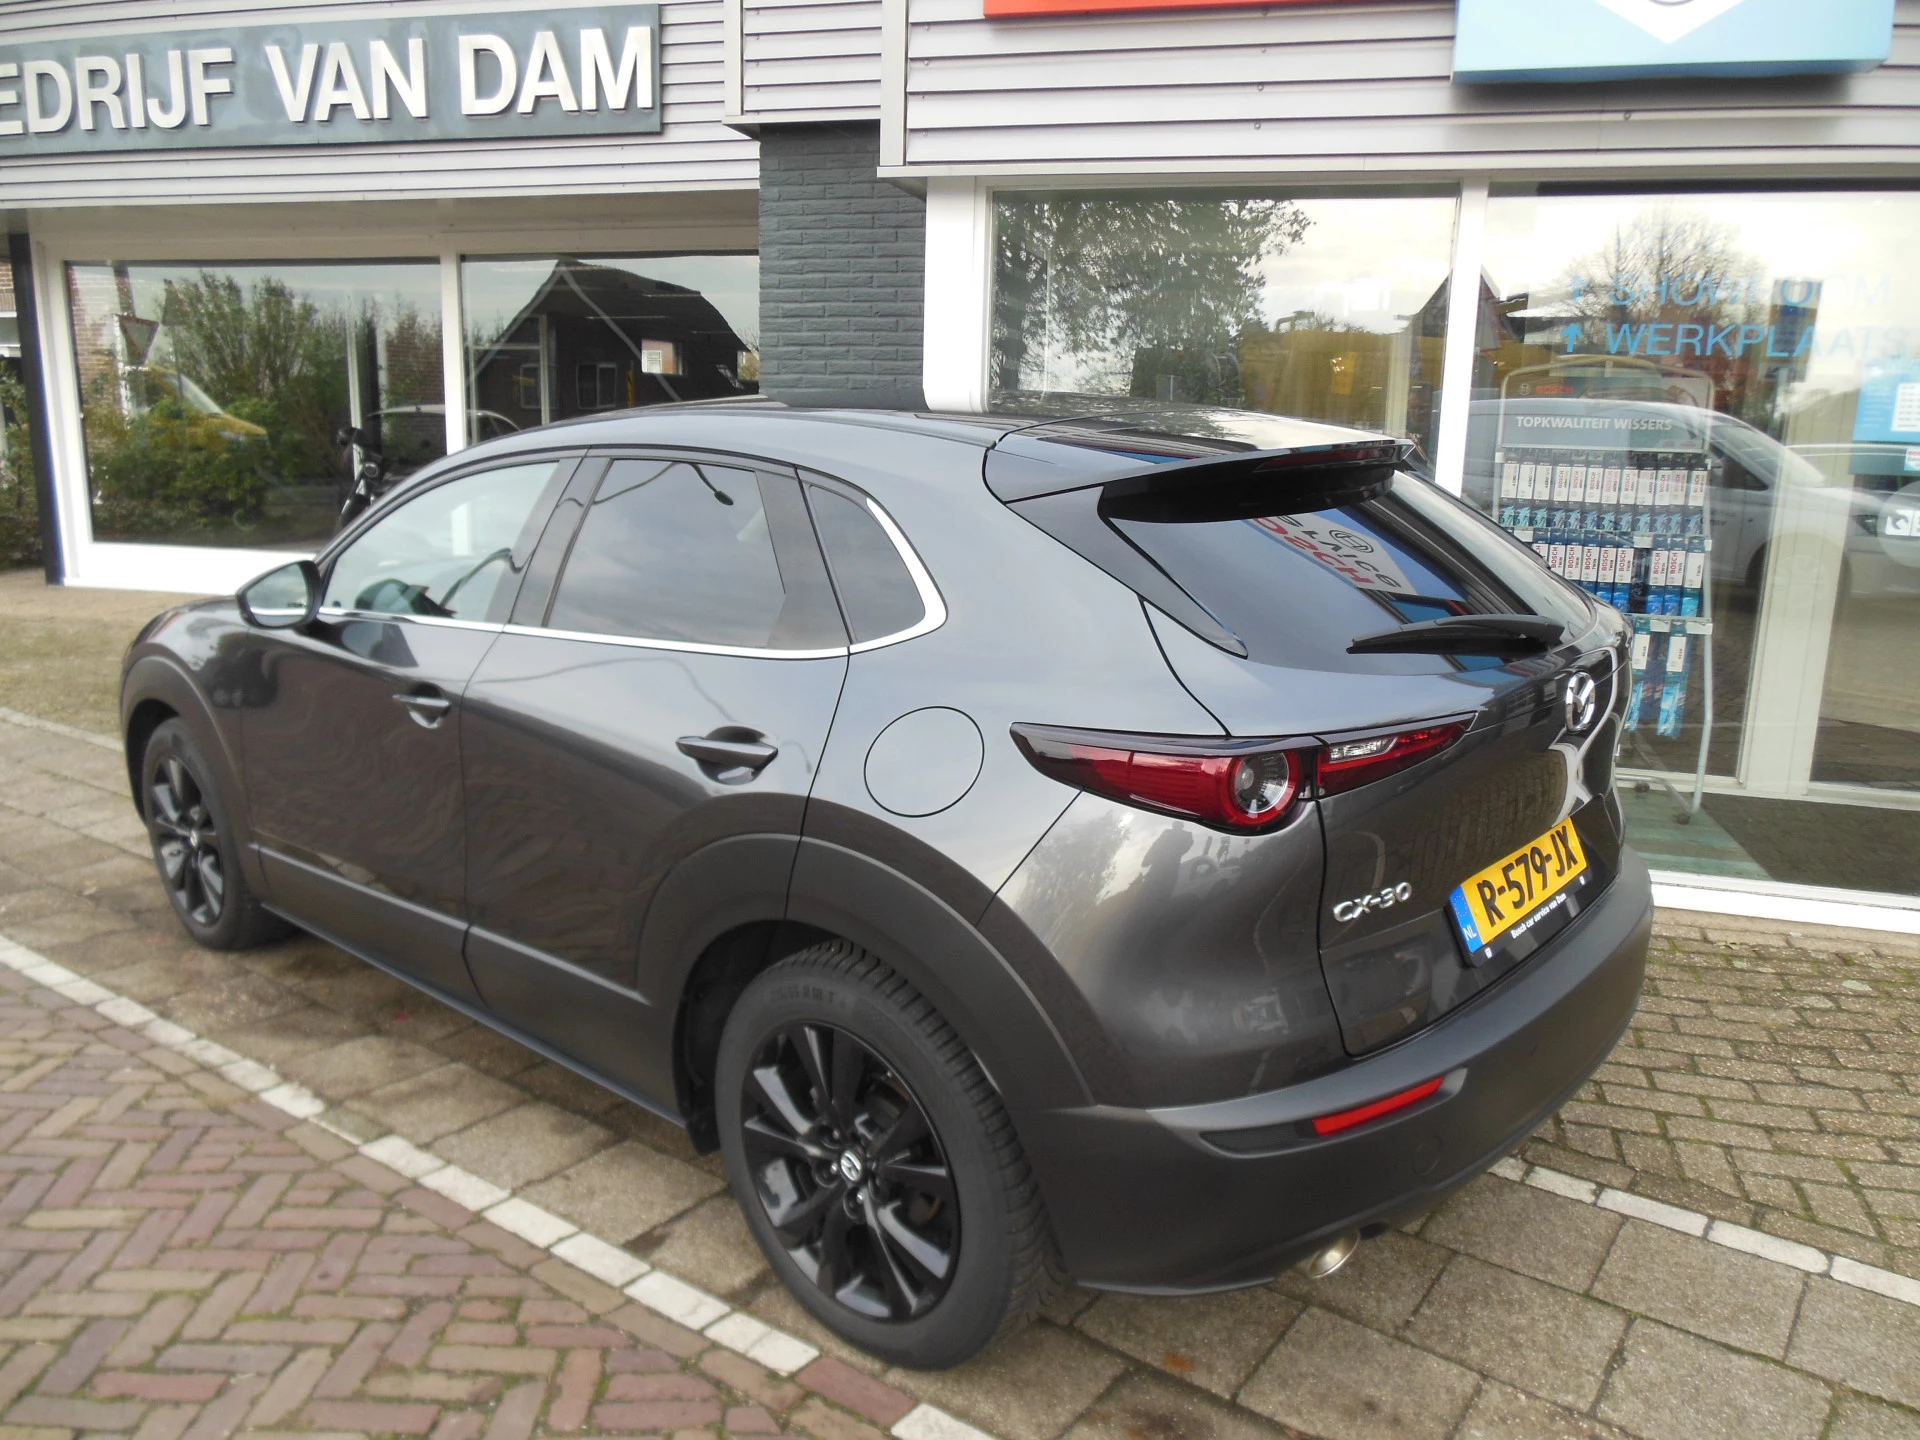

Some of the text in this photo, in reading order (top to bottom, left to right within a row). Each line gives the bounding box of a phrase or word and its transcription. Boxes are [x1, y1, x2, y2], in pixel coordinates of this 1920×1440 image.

[266, 38, 427, 123] VAN
[458, 26, 654, 117] DAM
[1516, 416, 1673, 430] TOPKWALITEIT WISSERS
[1670, 553, 1678, 574] BOSCH
[1477, 825, 1578, 927] R-579-JX
[1332, 881, 1412, 923] CX-30
[1462, 924, 1477, 941] NL
[1511, 923, 1527, 939] Bosch
